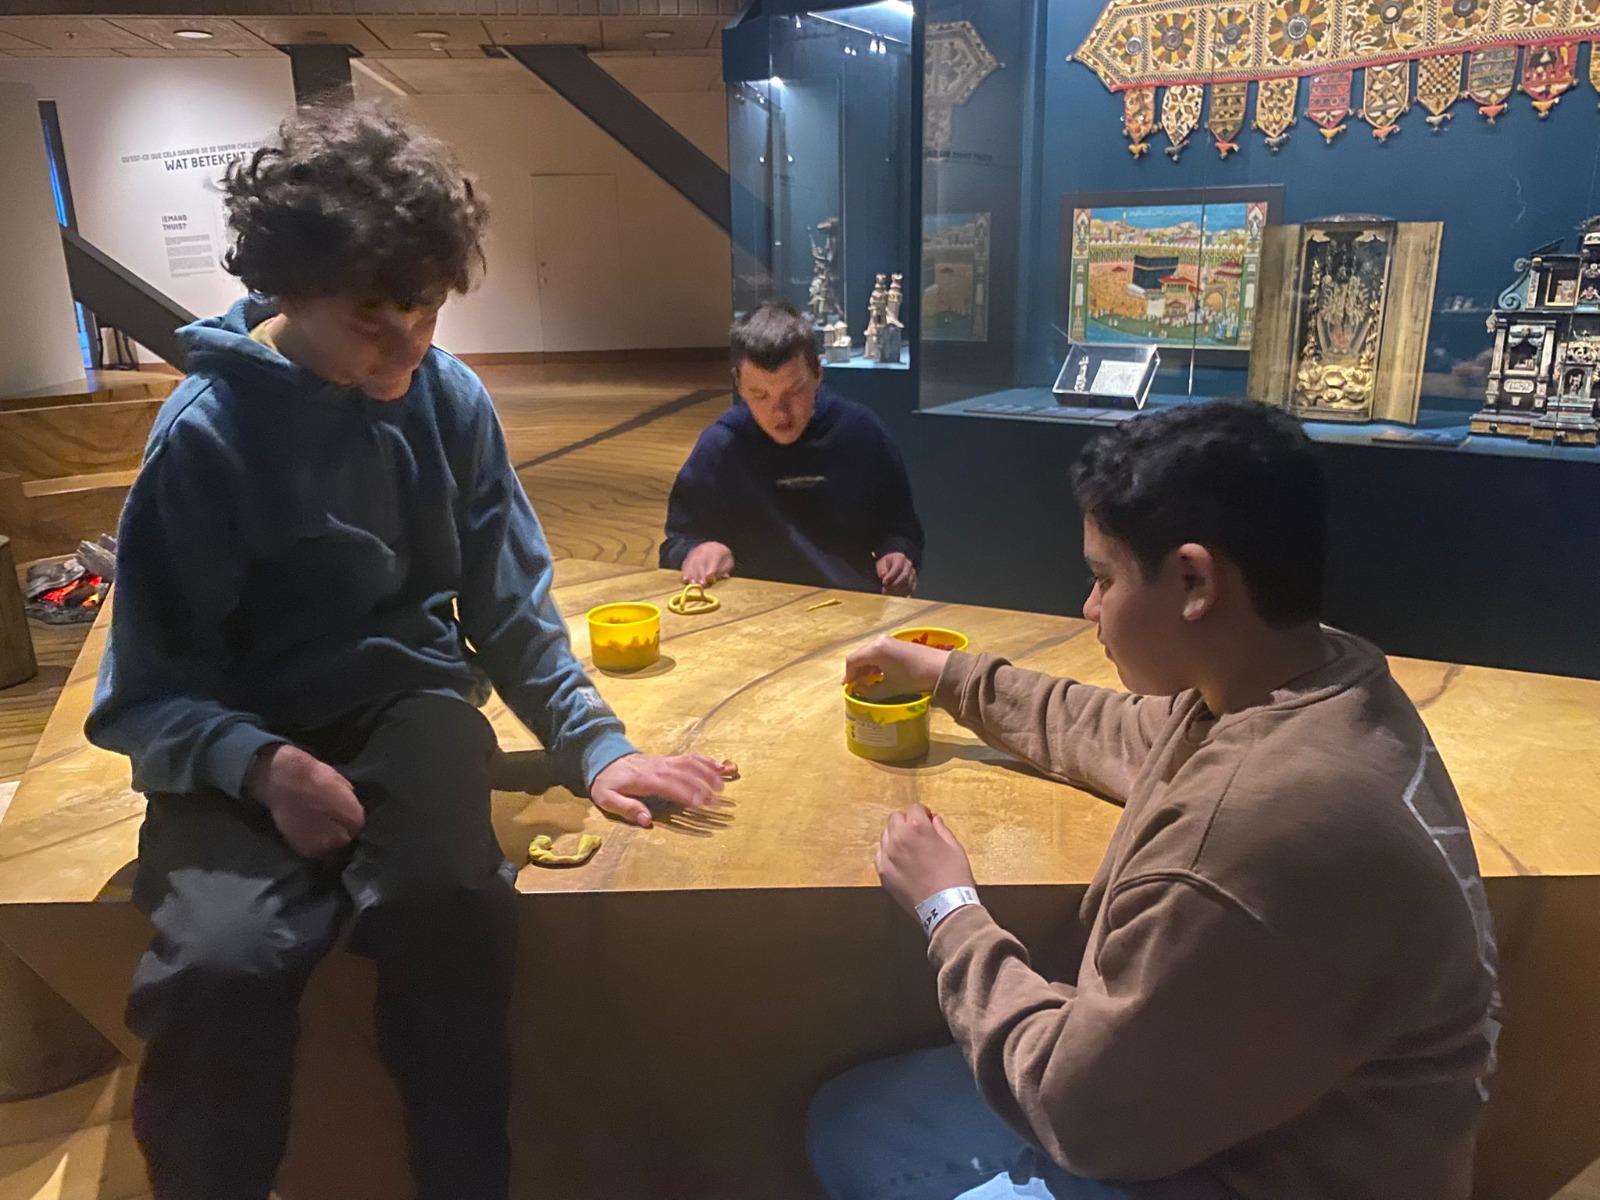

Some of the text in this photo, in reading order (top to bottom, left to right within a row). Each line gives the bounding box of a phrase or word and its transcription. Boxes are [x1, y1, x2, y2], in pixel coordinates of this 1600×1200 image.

[163, 150, 176, 159] CELA
[165, 157, 188, 171] WAT
[161, 214, 188, 223] IEMAND
